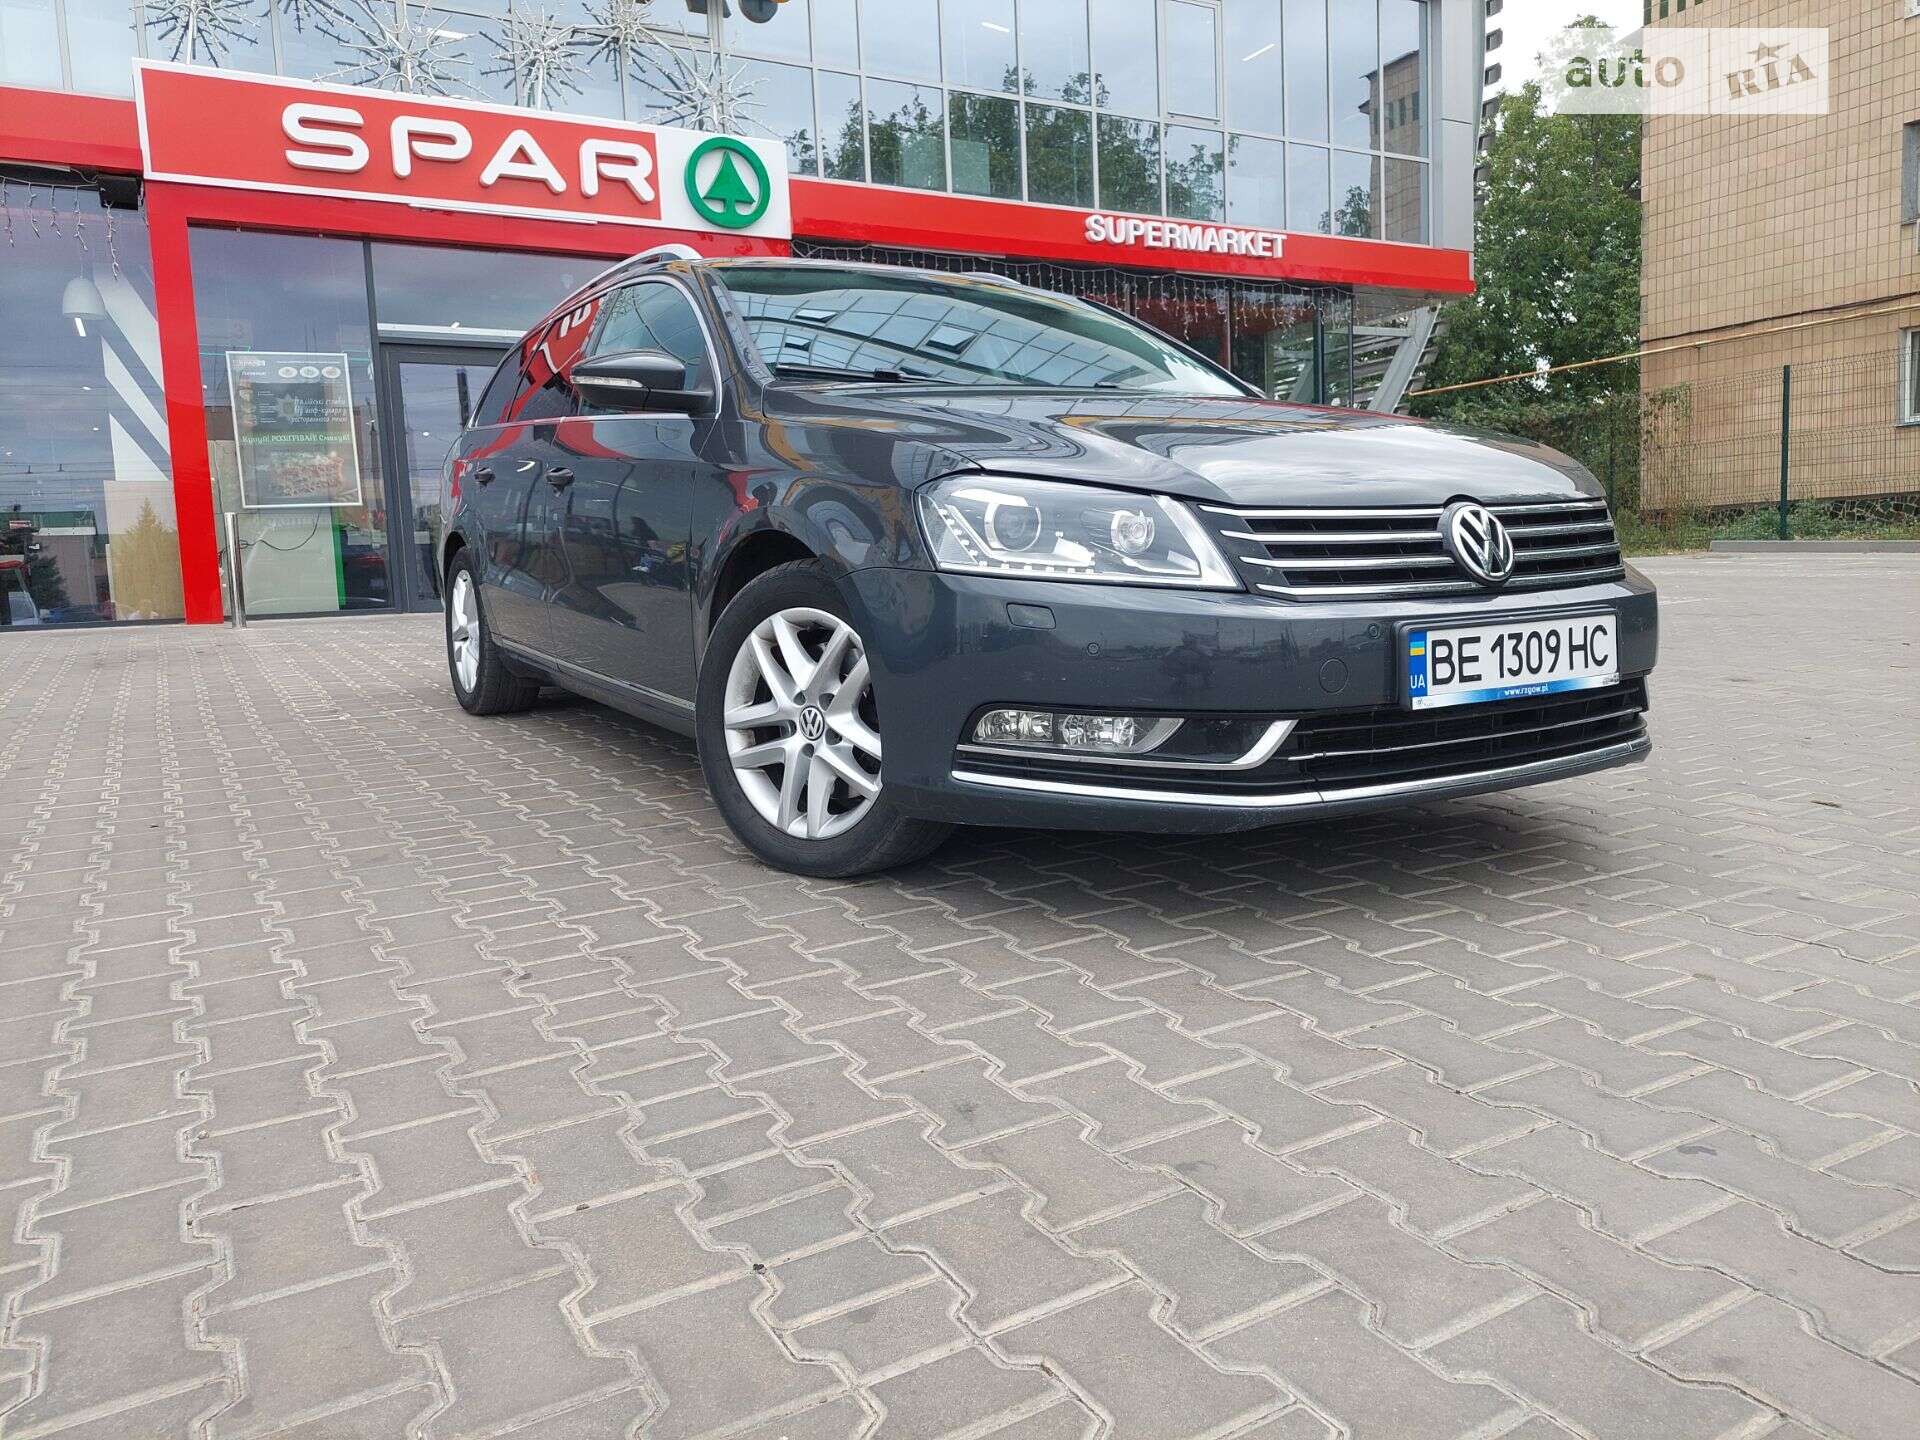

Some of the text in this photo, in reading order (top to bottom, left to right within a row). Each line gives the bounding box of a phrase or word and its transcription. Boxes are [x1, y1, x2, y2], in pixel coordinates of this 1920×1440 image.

[281, 102, 656, 204] SPAR
[1084, 214, 1288, 259] SUPERMARKET
[1431, 624, 1609, 686] BE 1309 HC
[1410, 674, 1426, 689] UA
[1503, 684, 1550, 696] www.rzgow.pl
